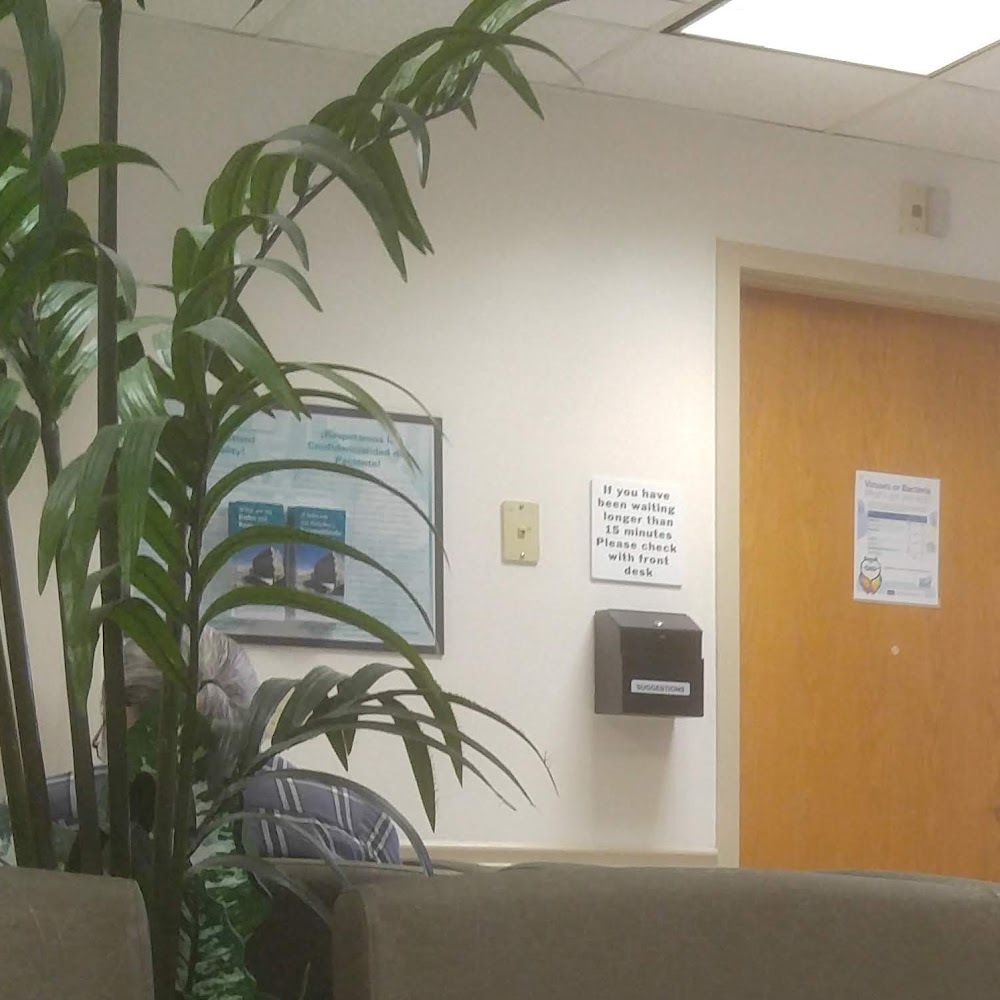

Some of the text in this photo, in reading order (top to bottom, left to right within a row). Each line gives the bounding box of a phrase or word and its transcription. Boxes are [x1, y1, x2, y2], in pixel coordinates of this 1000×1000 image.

[603, 484, 670, 501] If you have
[597, 497, 676, 516] been waiting
[603, 511, 674, 527] longer than
[605, 524, 673, 540] 15 minutes
[596, 536, 677, 553] Please check
[608, 552, 670, 565] with front
[624, 566, 653, 577] desk
